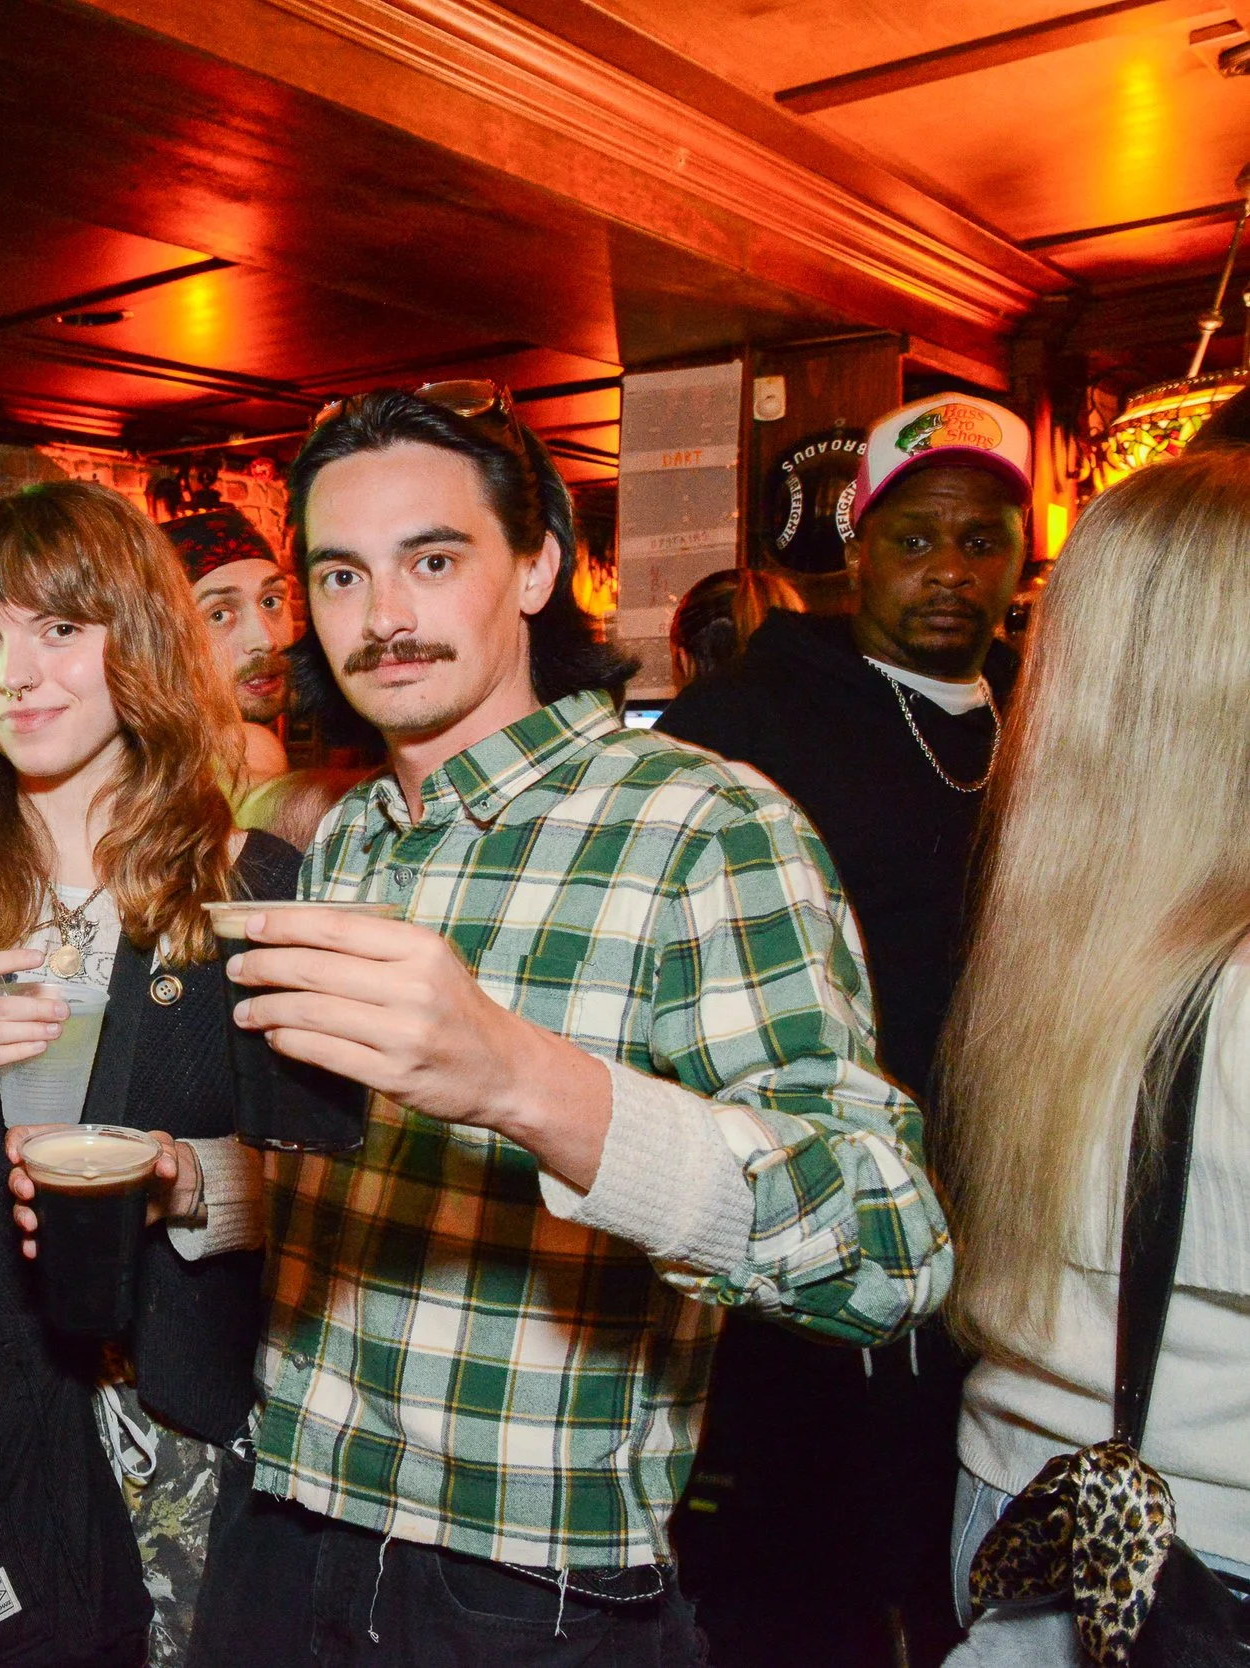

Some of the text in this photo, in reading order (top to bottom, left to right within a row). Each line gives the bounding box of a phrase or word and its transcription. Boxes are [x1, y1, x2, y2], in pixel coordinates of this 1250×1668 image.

[944, 405, 985, 421] Bass
[946, 418, 975, 431] Pro
[946, 429, 994, 449] Shops
[782, 440, 867, 472] BROADUS
[776, 473, 803, 550] IREFIGHTE
